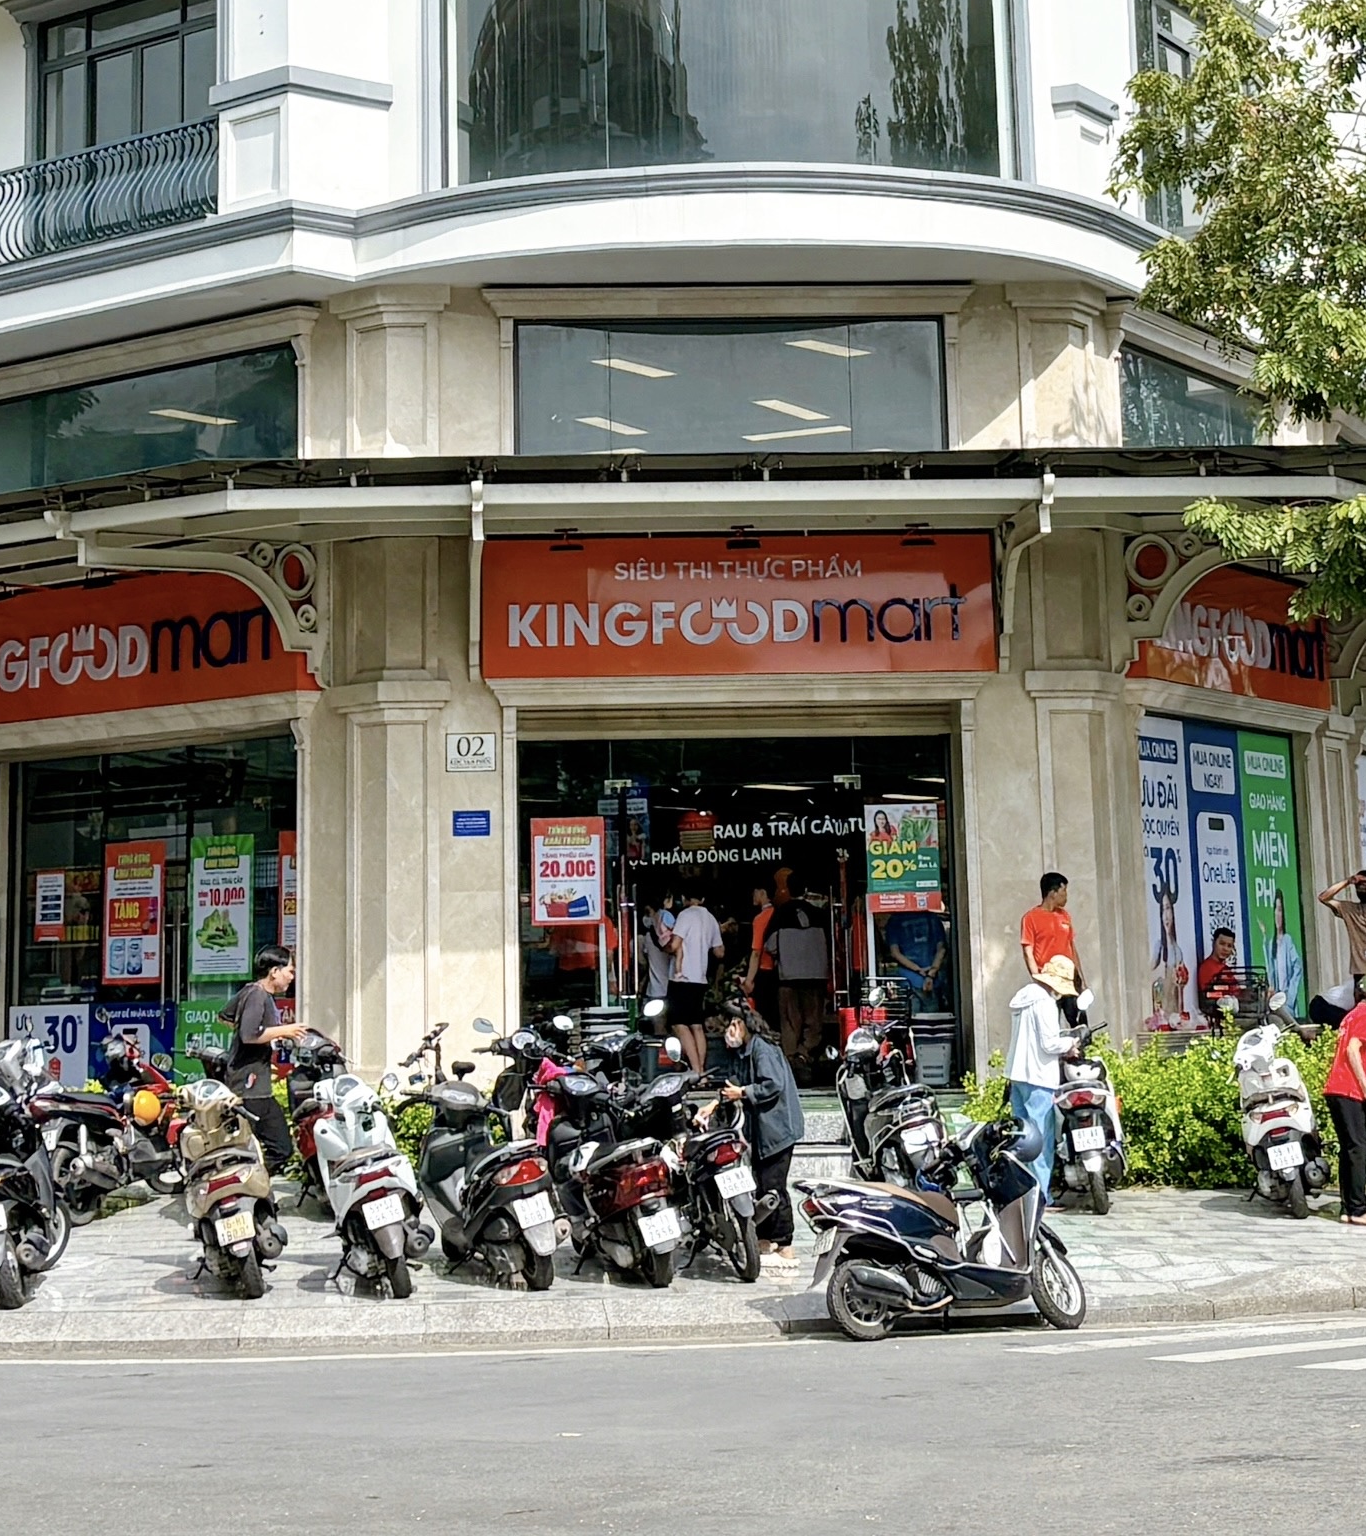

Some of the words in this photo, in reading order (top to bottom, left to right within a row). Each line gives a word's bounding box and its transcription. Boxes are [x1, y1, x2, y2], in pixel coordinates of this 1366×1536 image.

[614, 559, 667, 581] SIÊU
[673, 561, 712, 581] THỊ
[718, 558, 785, 583] THỰC
[791, 552, 862, 579] PHẨM
[457, 736, 485, 757] 02
[1152, 742, 1176, 760] ONLINE
[1192, 750, 1207, 765] MUA
[1208, 752, 1232, 769] ONLINE
[1157, 775, 1177, 810] ĐÃI
[1248, 792, 1265, 810] GIAO
[1266, 790, 1286, 812] HÀNG
[713, 823, 747, 839] RAU
[751, 822, 764, 838] &
[870, 835, 917, 855] GIẢM
[1252, 815, 1289, 868] MIỄN
[743, 848, 782, 864] LẠNH
[871, 859, 917, 879] 20%
[1202, 861, 1236, 884] OneLife
[1255, 868, 1276, 907] PHÍ
[114, 900, 140, 921] TẶNG
[186, 1011, 210, 1023] GIAO
